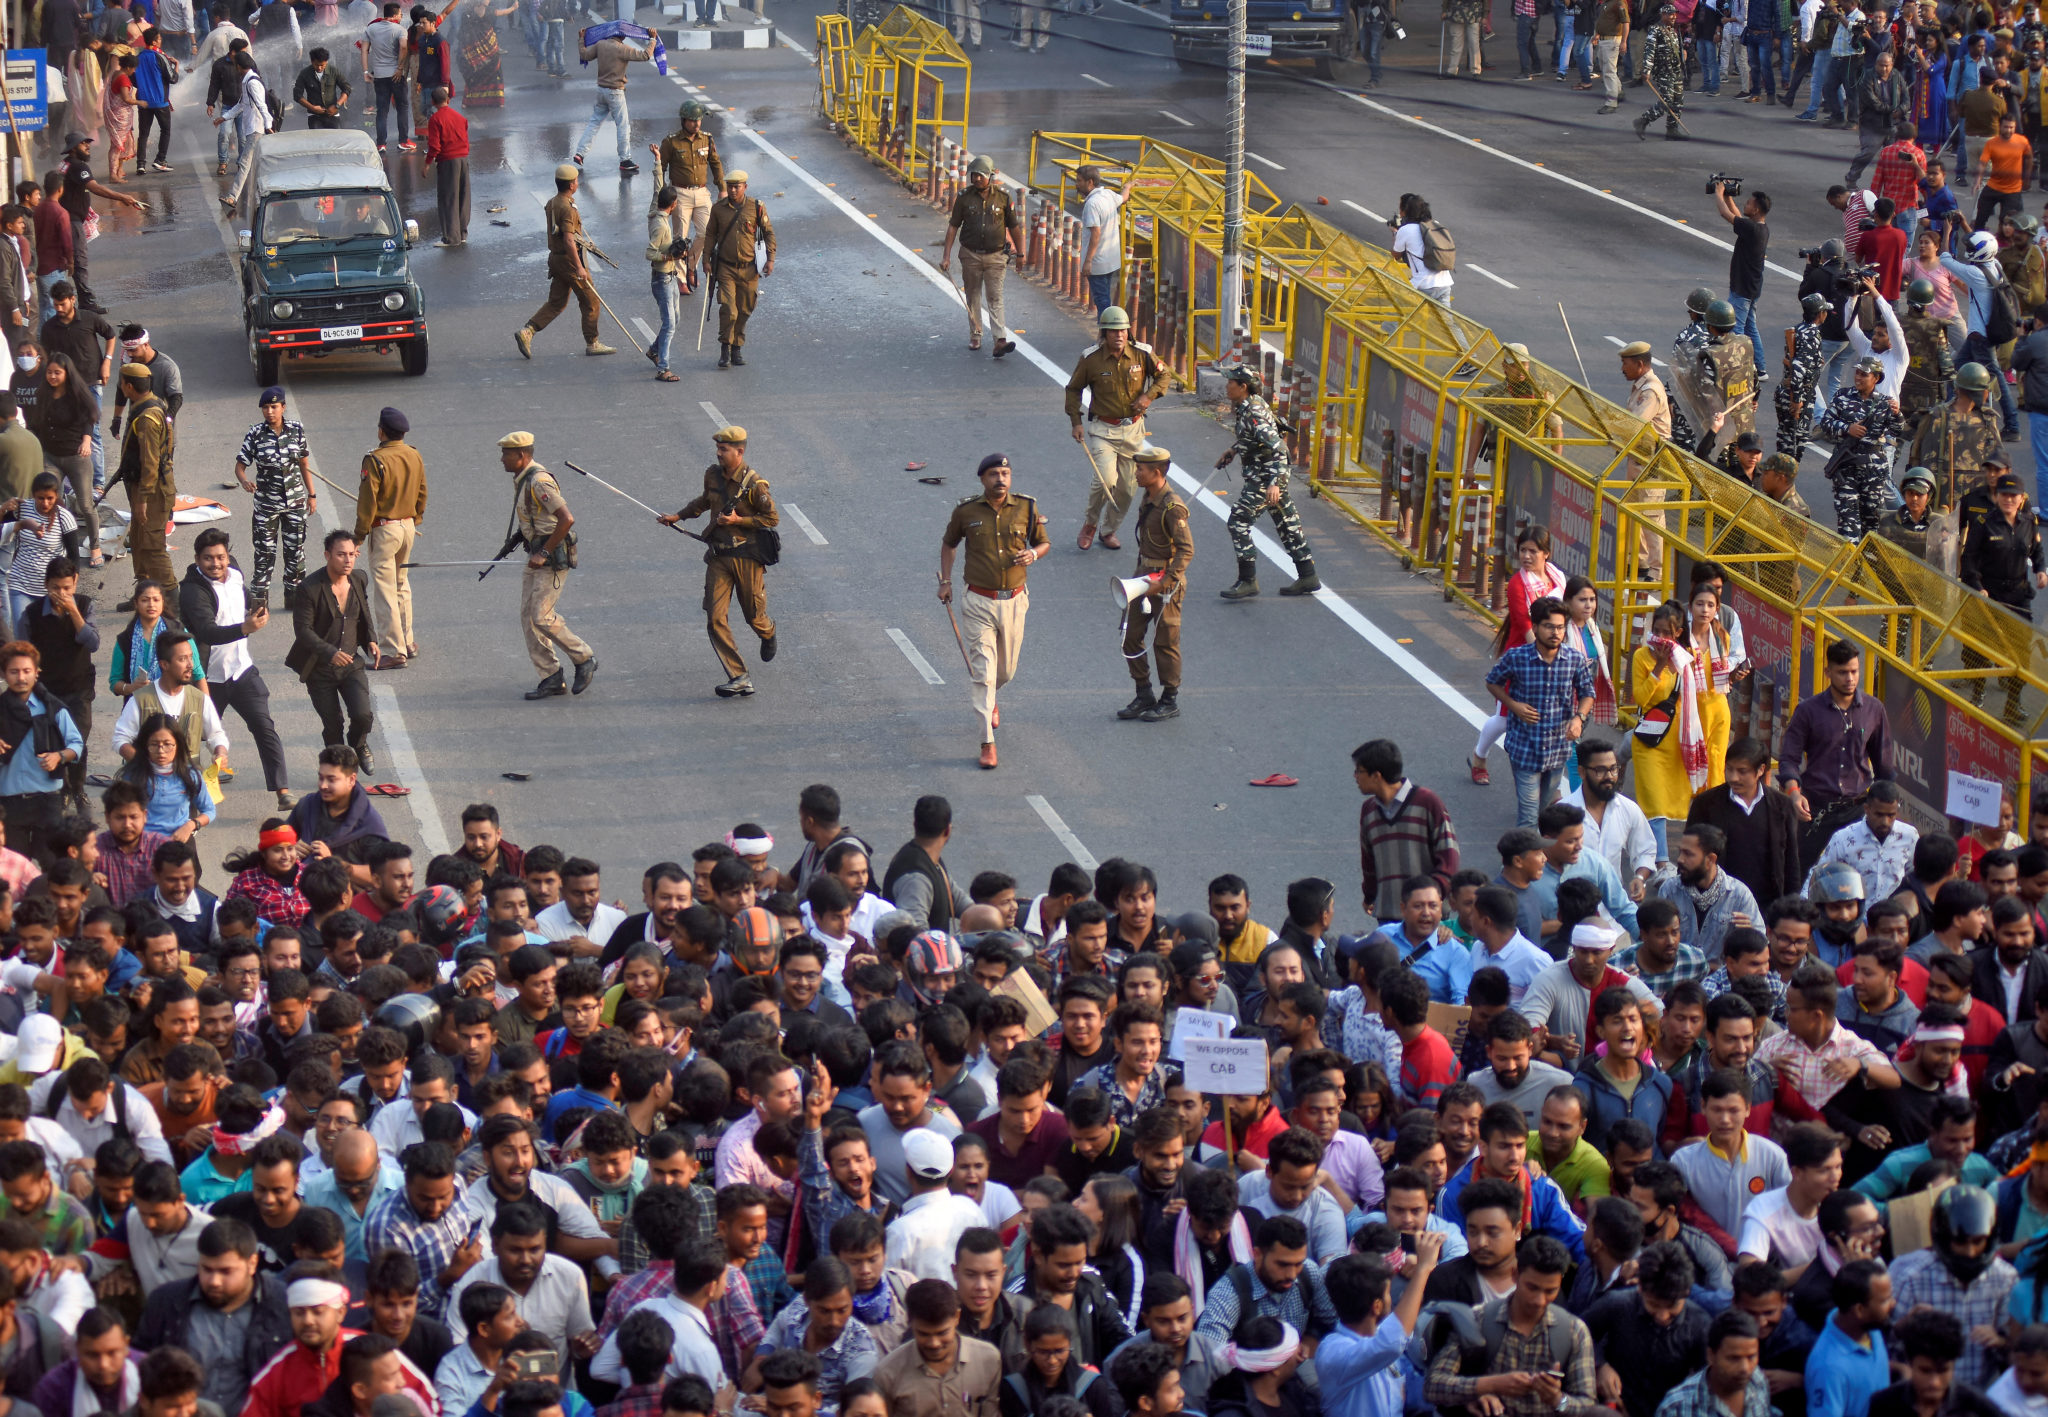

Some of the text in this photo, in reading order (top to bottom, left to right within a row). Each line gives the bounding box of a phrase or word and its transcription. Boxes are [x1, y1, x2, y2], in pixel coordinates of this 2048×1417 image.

[16, 86, 33, 94] STOP
[2, 105, 34, 113] ASSAM
[15, 387, 37, 396] STAY
[1727, 378, 1748, 398] POLICE
[1554, 470, 1571, 500] OBEY
[1893, 740, 1929, 790] NRL
[1964, 794, 1980, 807] CAB
[1188, 1016, 1213, 1028] SAY NO
[1196, 1045, 1249, 1056] WE OPPOSE
[1210, 1063, 1236, 1074] CAB
